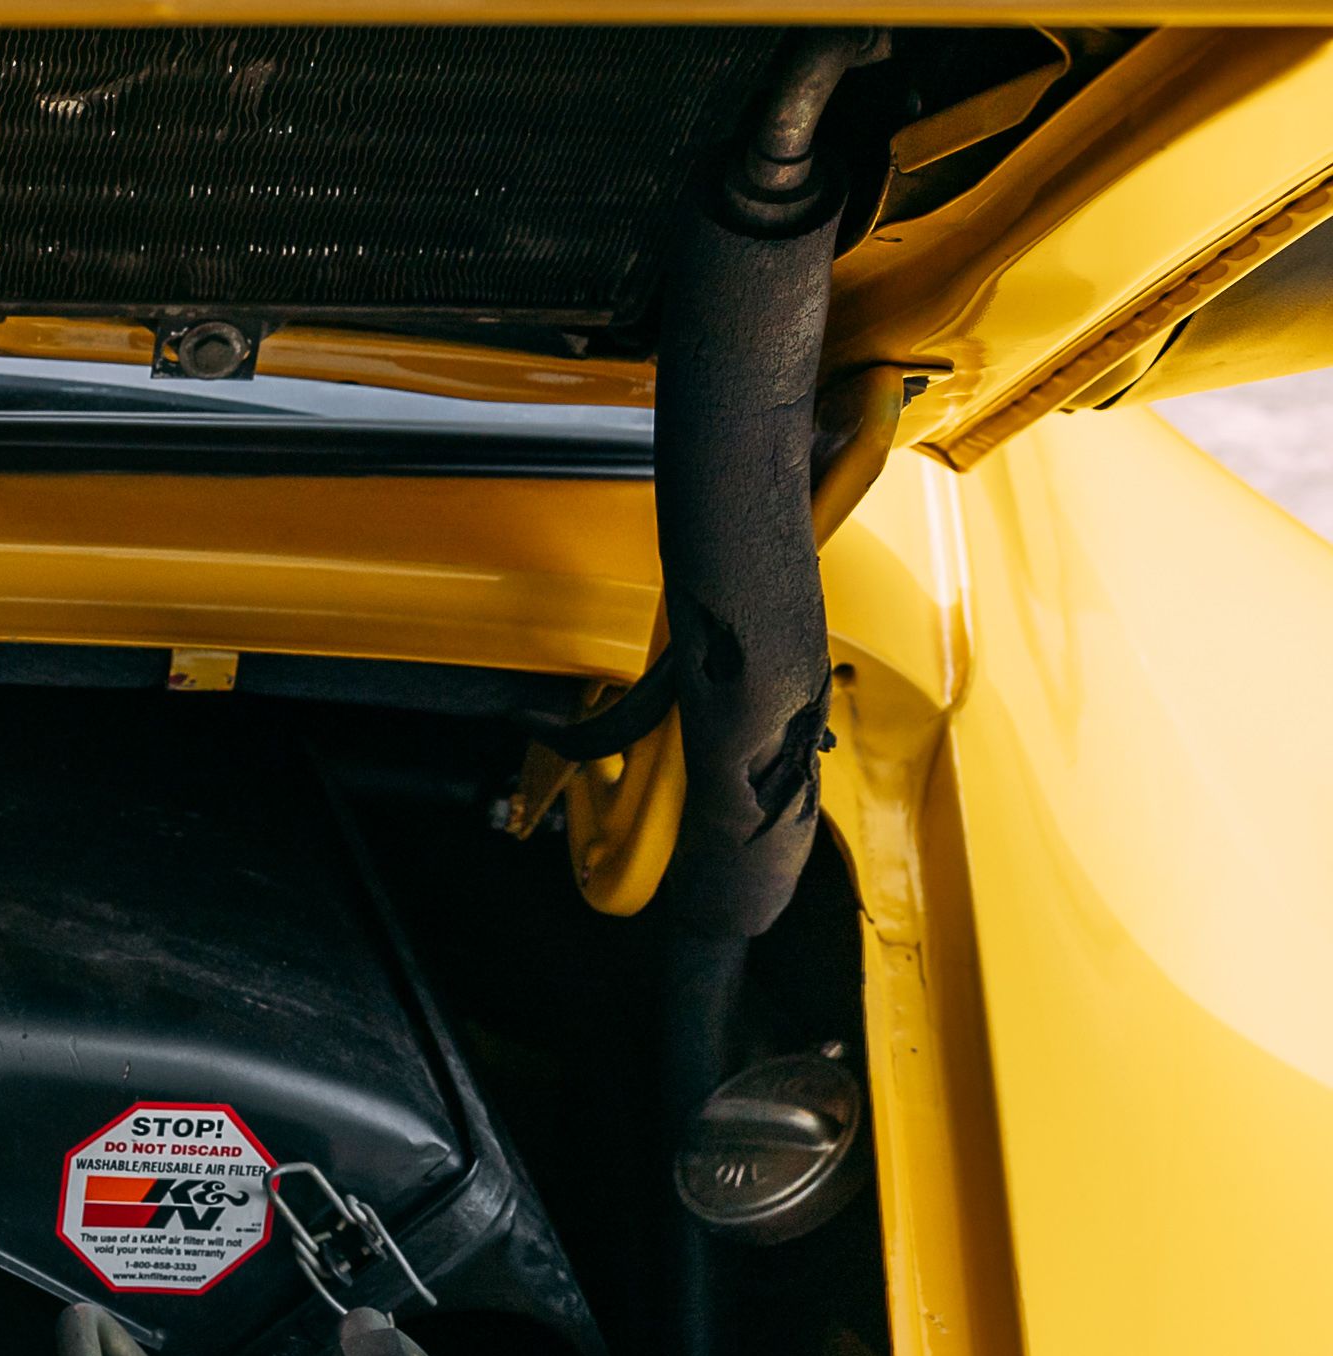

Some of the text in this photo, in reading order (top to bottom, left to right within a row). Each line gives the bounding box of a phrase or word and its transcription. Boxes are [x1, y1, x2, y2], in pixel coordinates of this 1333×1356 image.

[131, 1116, 224, 1139] STOP!
[104, 1141, 243, 1157] DO NOT DISCARD
[76, 1158, 266, 1177] WASHABLE/REUSABLE AIR FILTER
[81, 1233, 98, 1243] The
[100, 1235, 118, 1243] use
[119, 1234, 130, 1243] of
[168, 1235, 181, 1245] air
[184, 1236, 205, 1246] filter
[208, 1237, 226, 1247] will
[228, 1238, 242, 1247] not
[94, 1245, 226, 1260] void your vehicle's warranty
[125, 1260, 197, 1271] 1-800-858-3333
